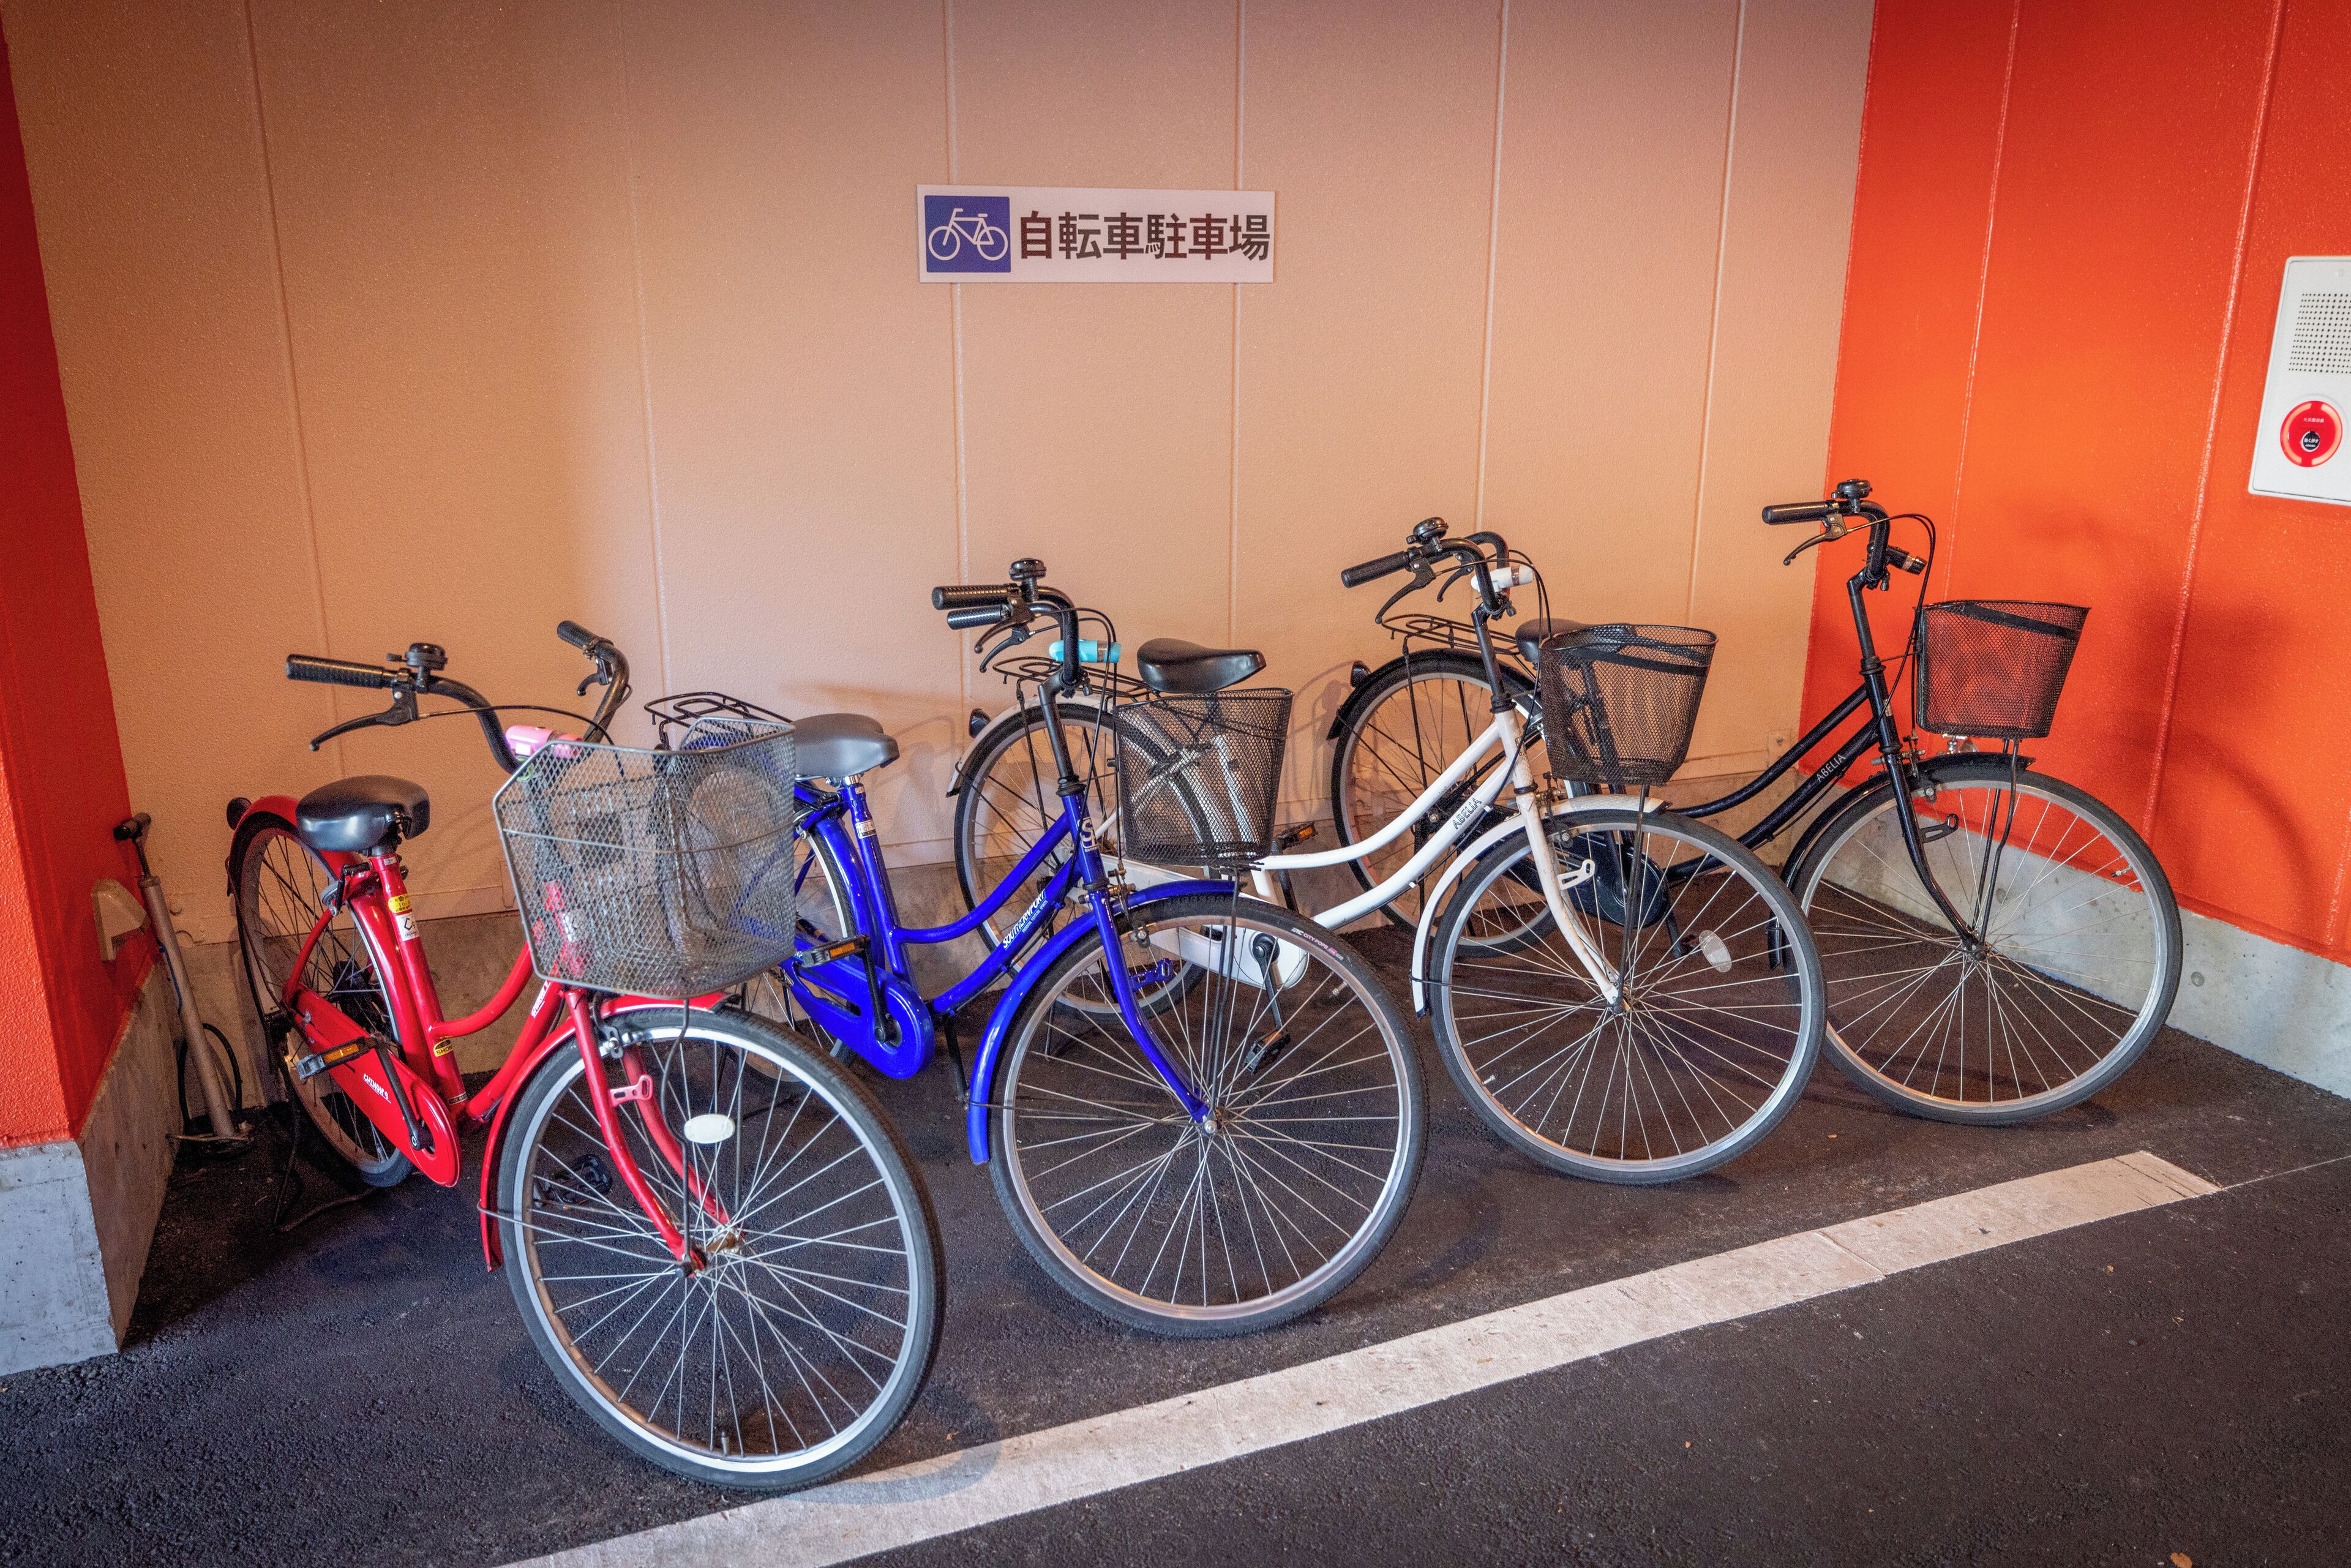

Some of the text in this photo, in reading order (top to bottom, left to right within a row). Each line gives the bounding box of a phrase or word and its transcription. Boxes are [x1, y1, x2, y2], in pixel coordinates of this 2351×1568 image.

[1020, 210, 1270, 261] 自転車駐車場
[1817, 754, 1846, 782] ABELIA
[1452, 798, 1482, 830] ABELIA
[1003, 888, 1045, 948] SOUTHERNPORT
[1303, 932, 1315, 941] CITY
[1314, 939, 1329, 950] POPS
